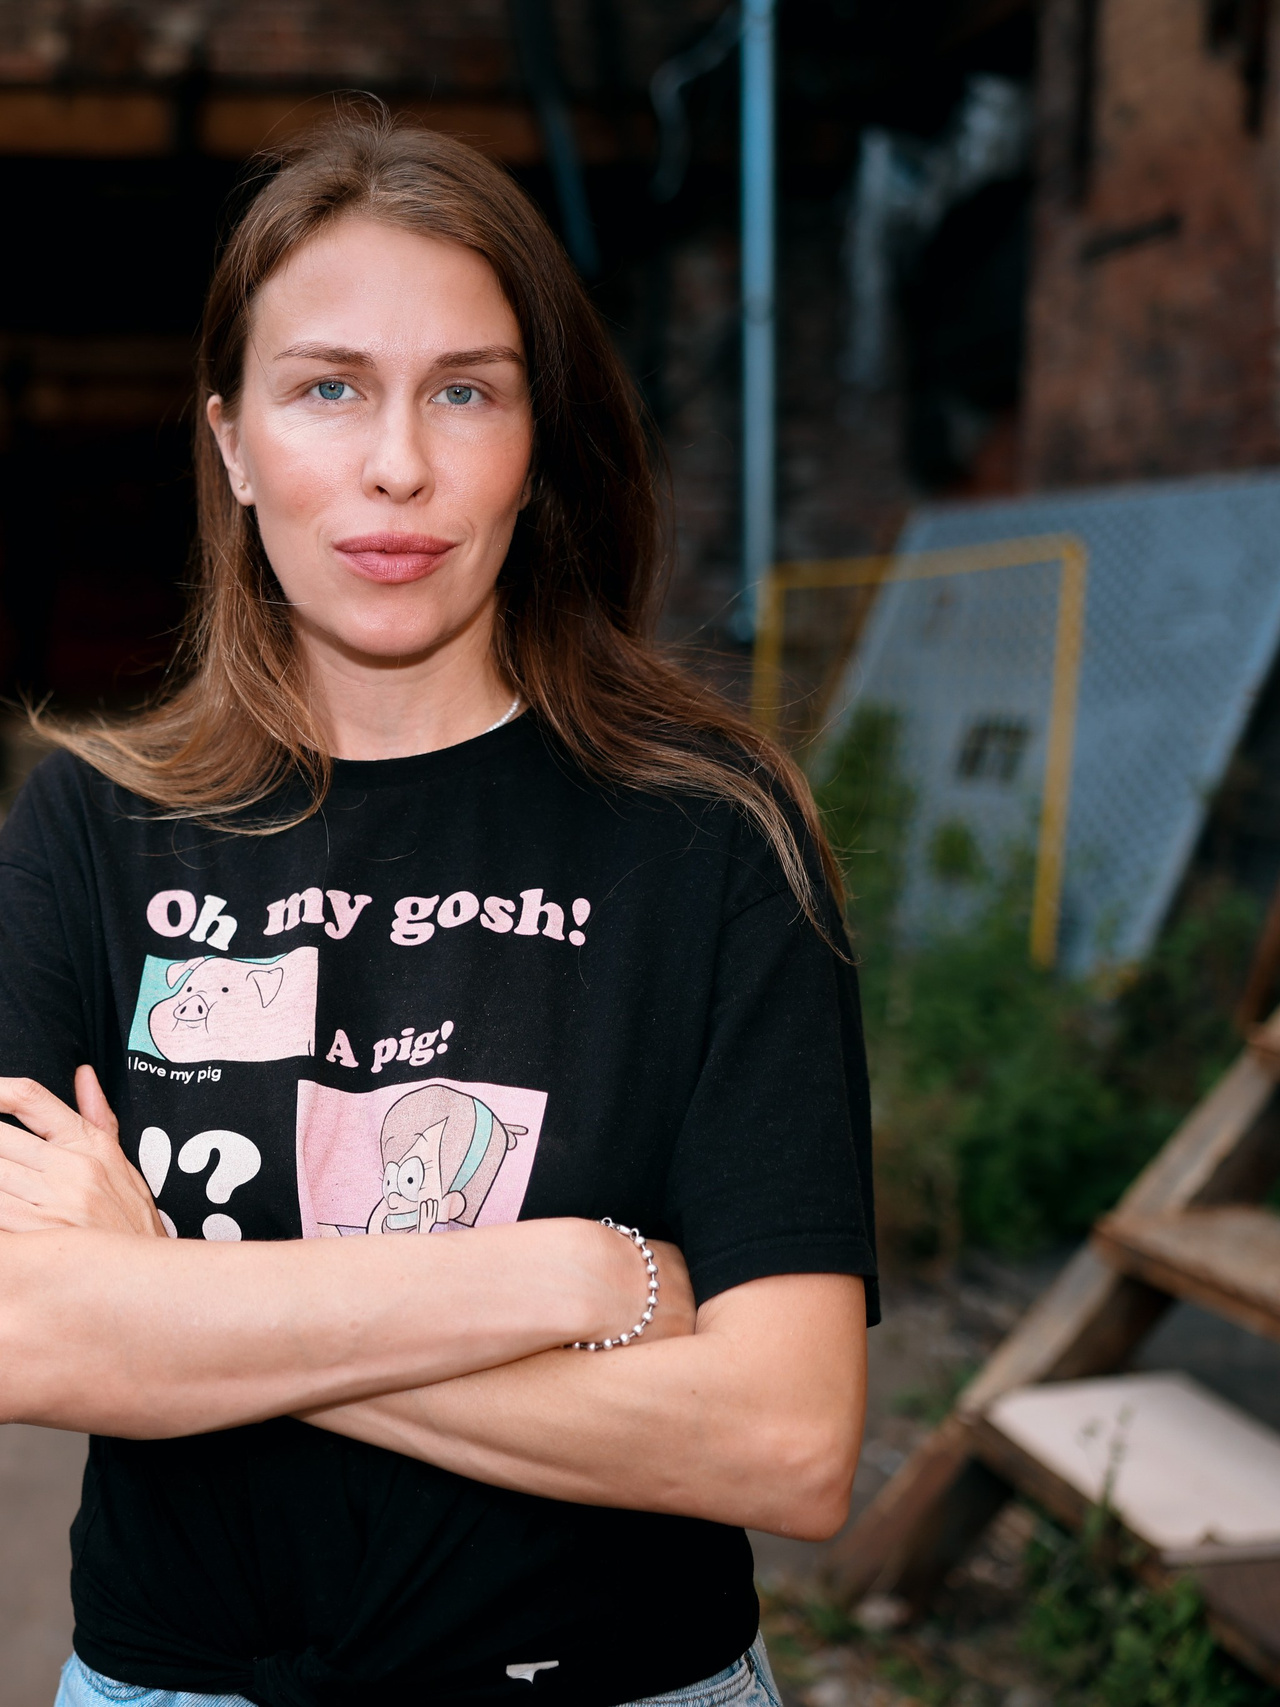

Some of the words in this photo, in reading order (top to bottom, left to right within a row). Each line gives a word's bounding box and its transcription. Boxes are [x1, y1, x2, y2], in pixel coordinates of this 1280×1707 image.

[146, 889, 238, 952] Oh
[262, 886, 373, 940] my
[389, 888, 592, 947] gosh!
[133, 1056, 167, 1078] love
[169, 1068, 195, 1084] my
[196, 1065, 222, 1083] pig
[325, 1028, 360, 1068] A
[370, 1020, 455, 1074] pig!
